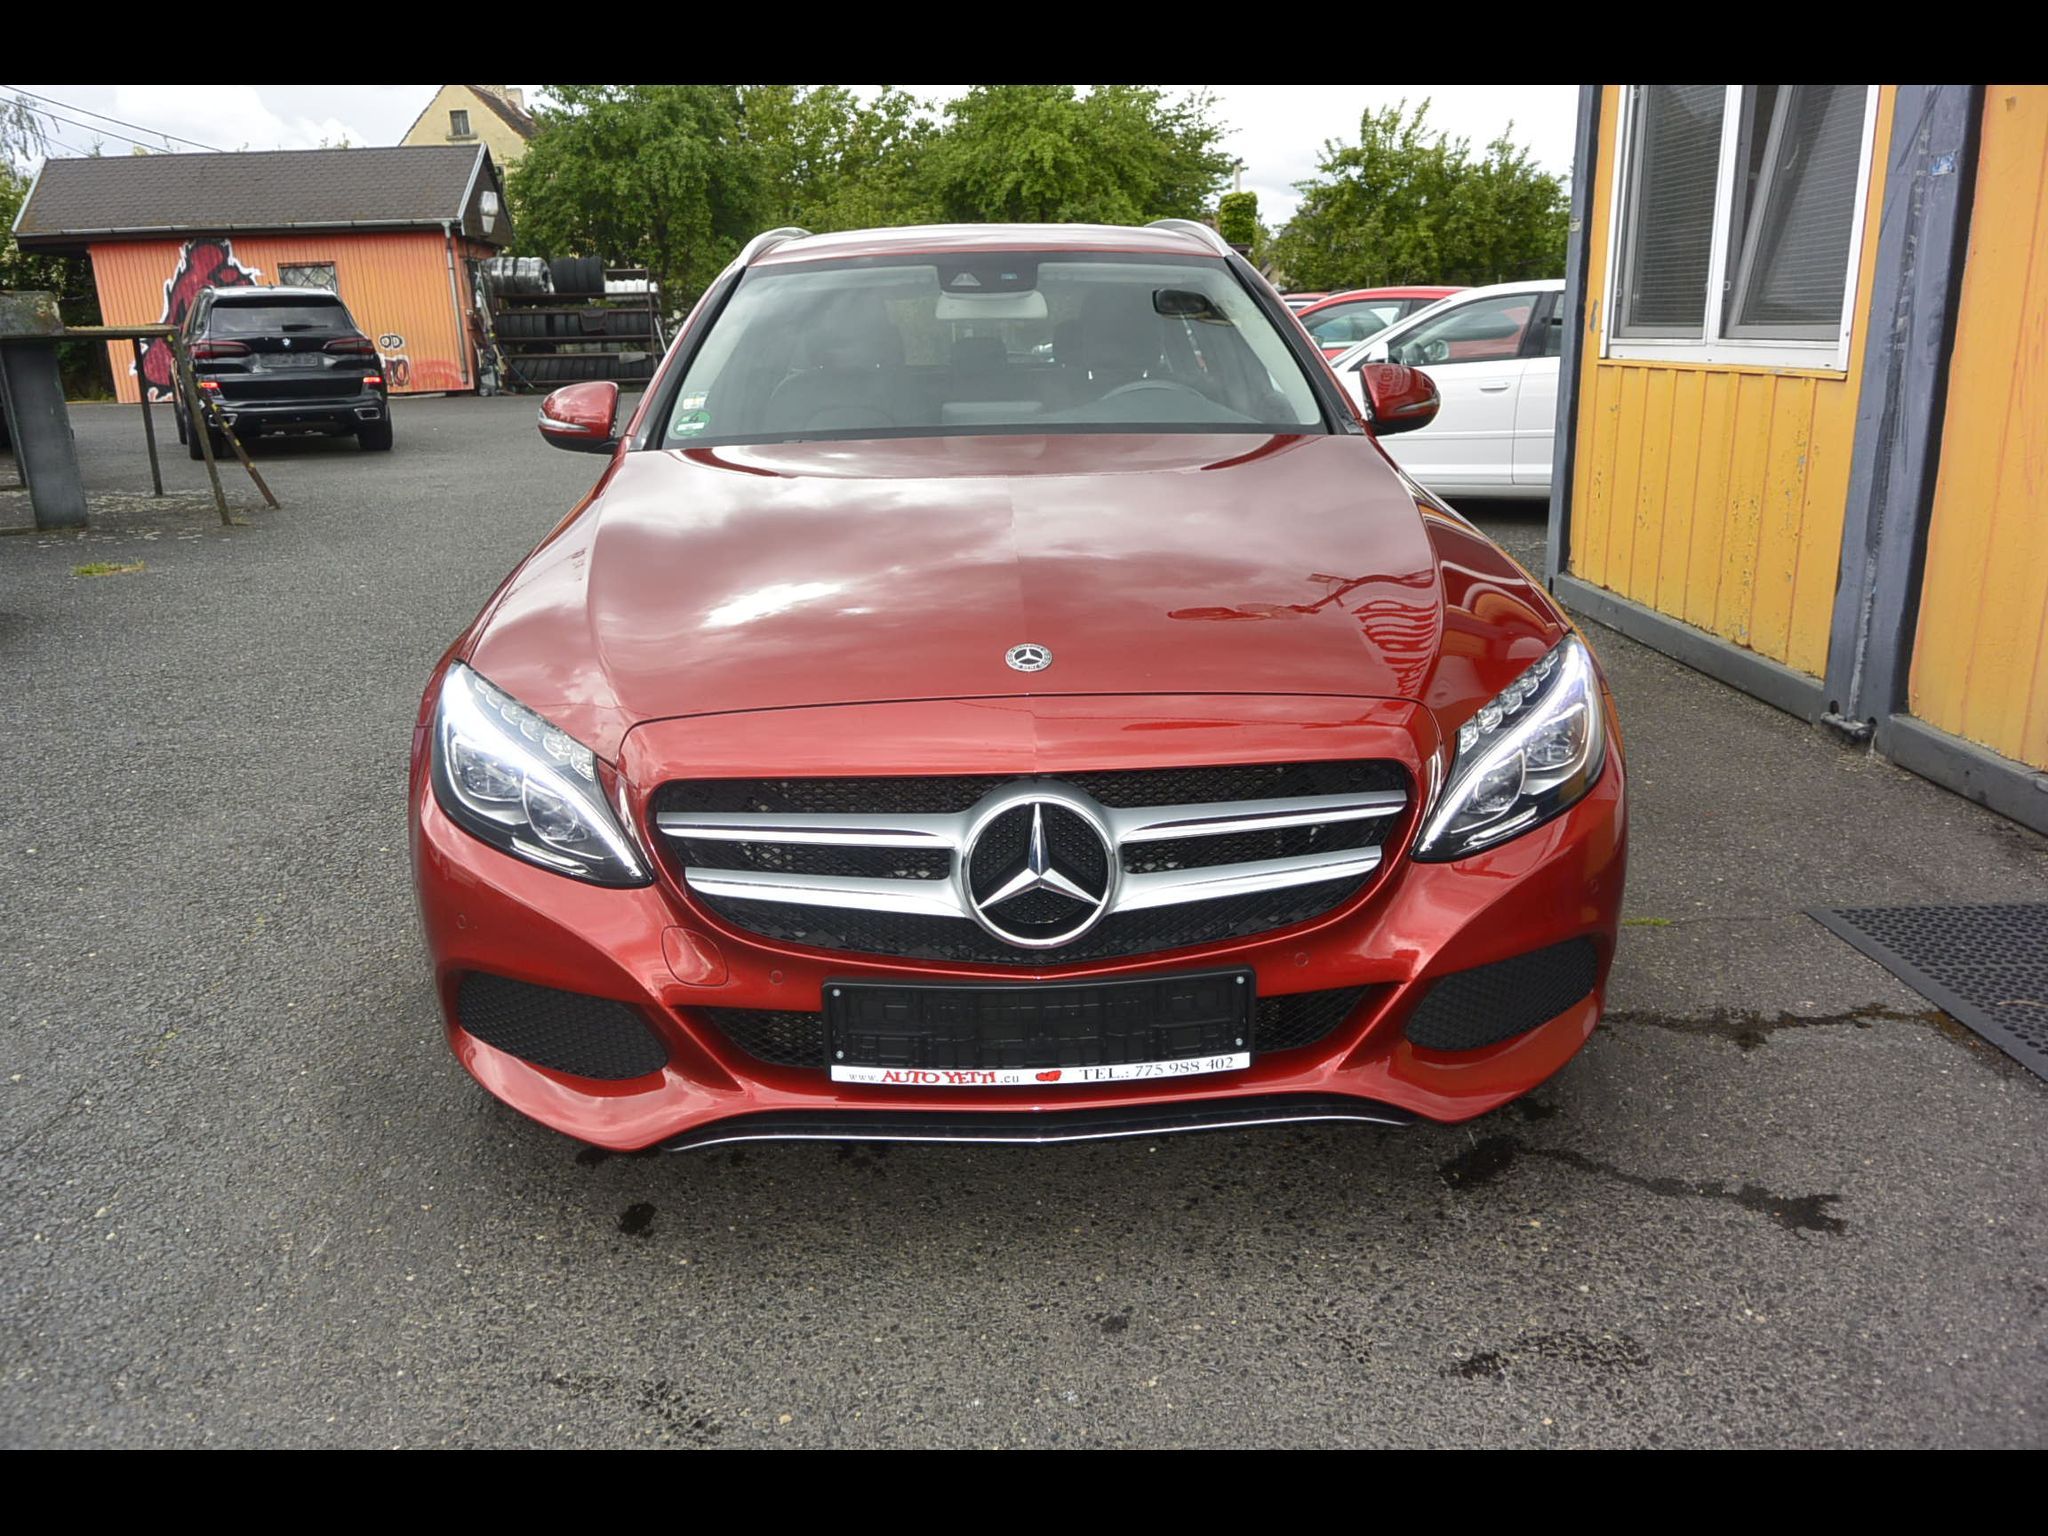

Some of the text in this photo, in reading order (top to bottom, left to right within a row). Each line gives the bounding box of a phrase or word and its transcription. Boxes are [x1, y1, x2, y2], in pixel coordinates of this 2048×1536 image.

[1135, 1064, 1164, 1077] 775
[1169, 1061, 1200, 1074] 988
[1206, 1056, 1233, 1070] 402
